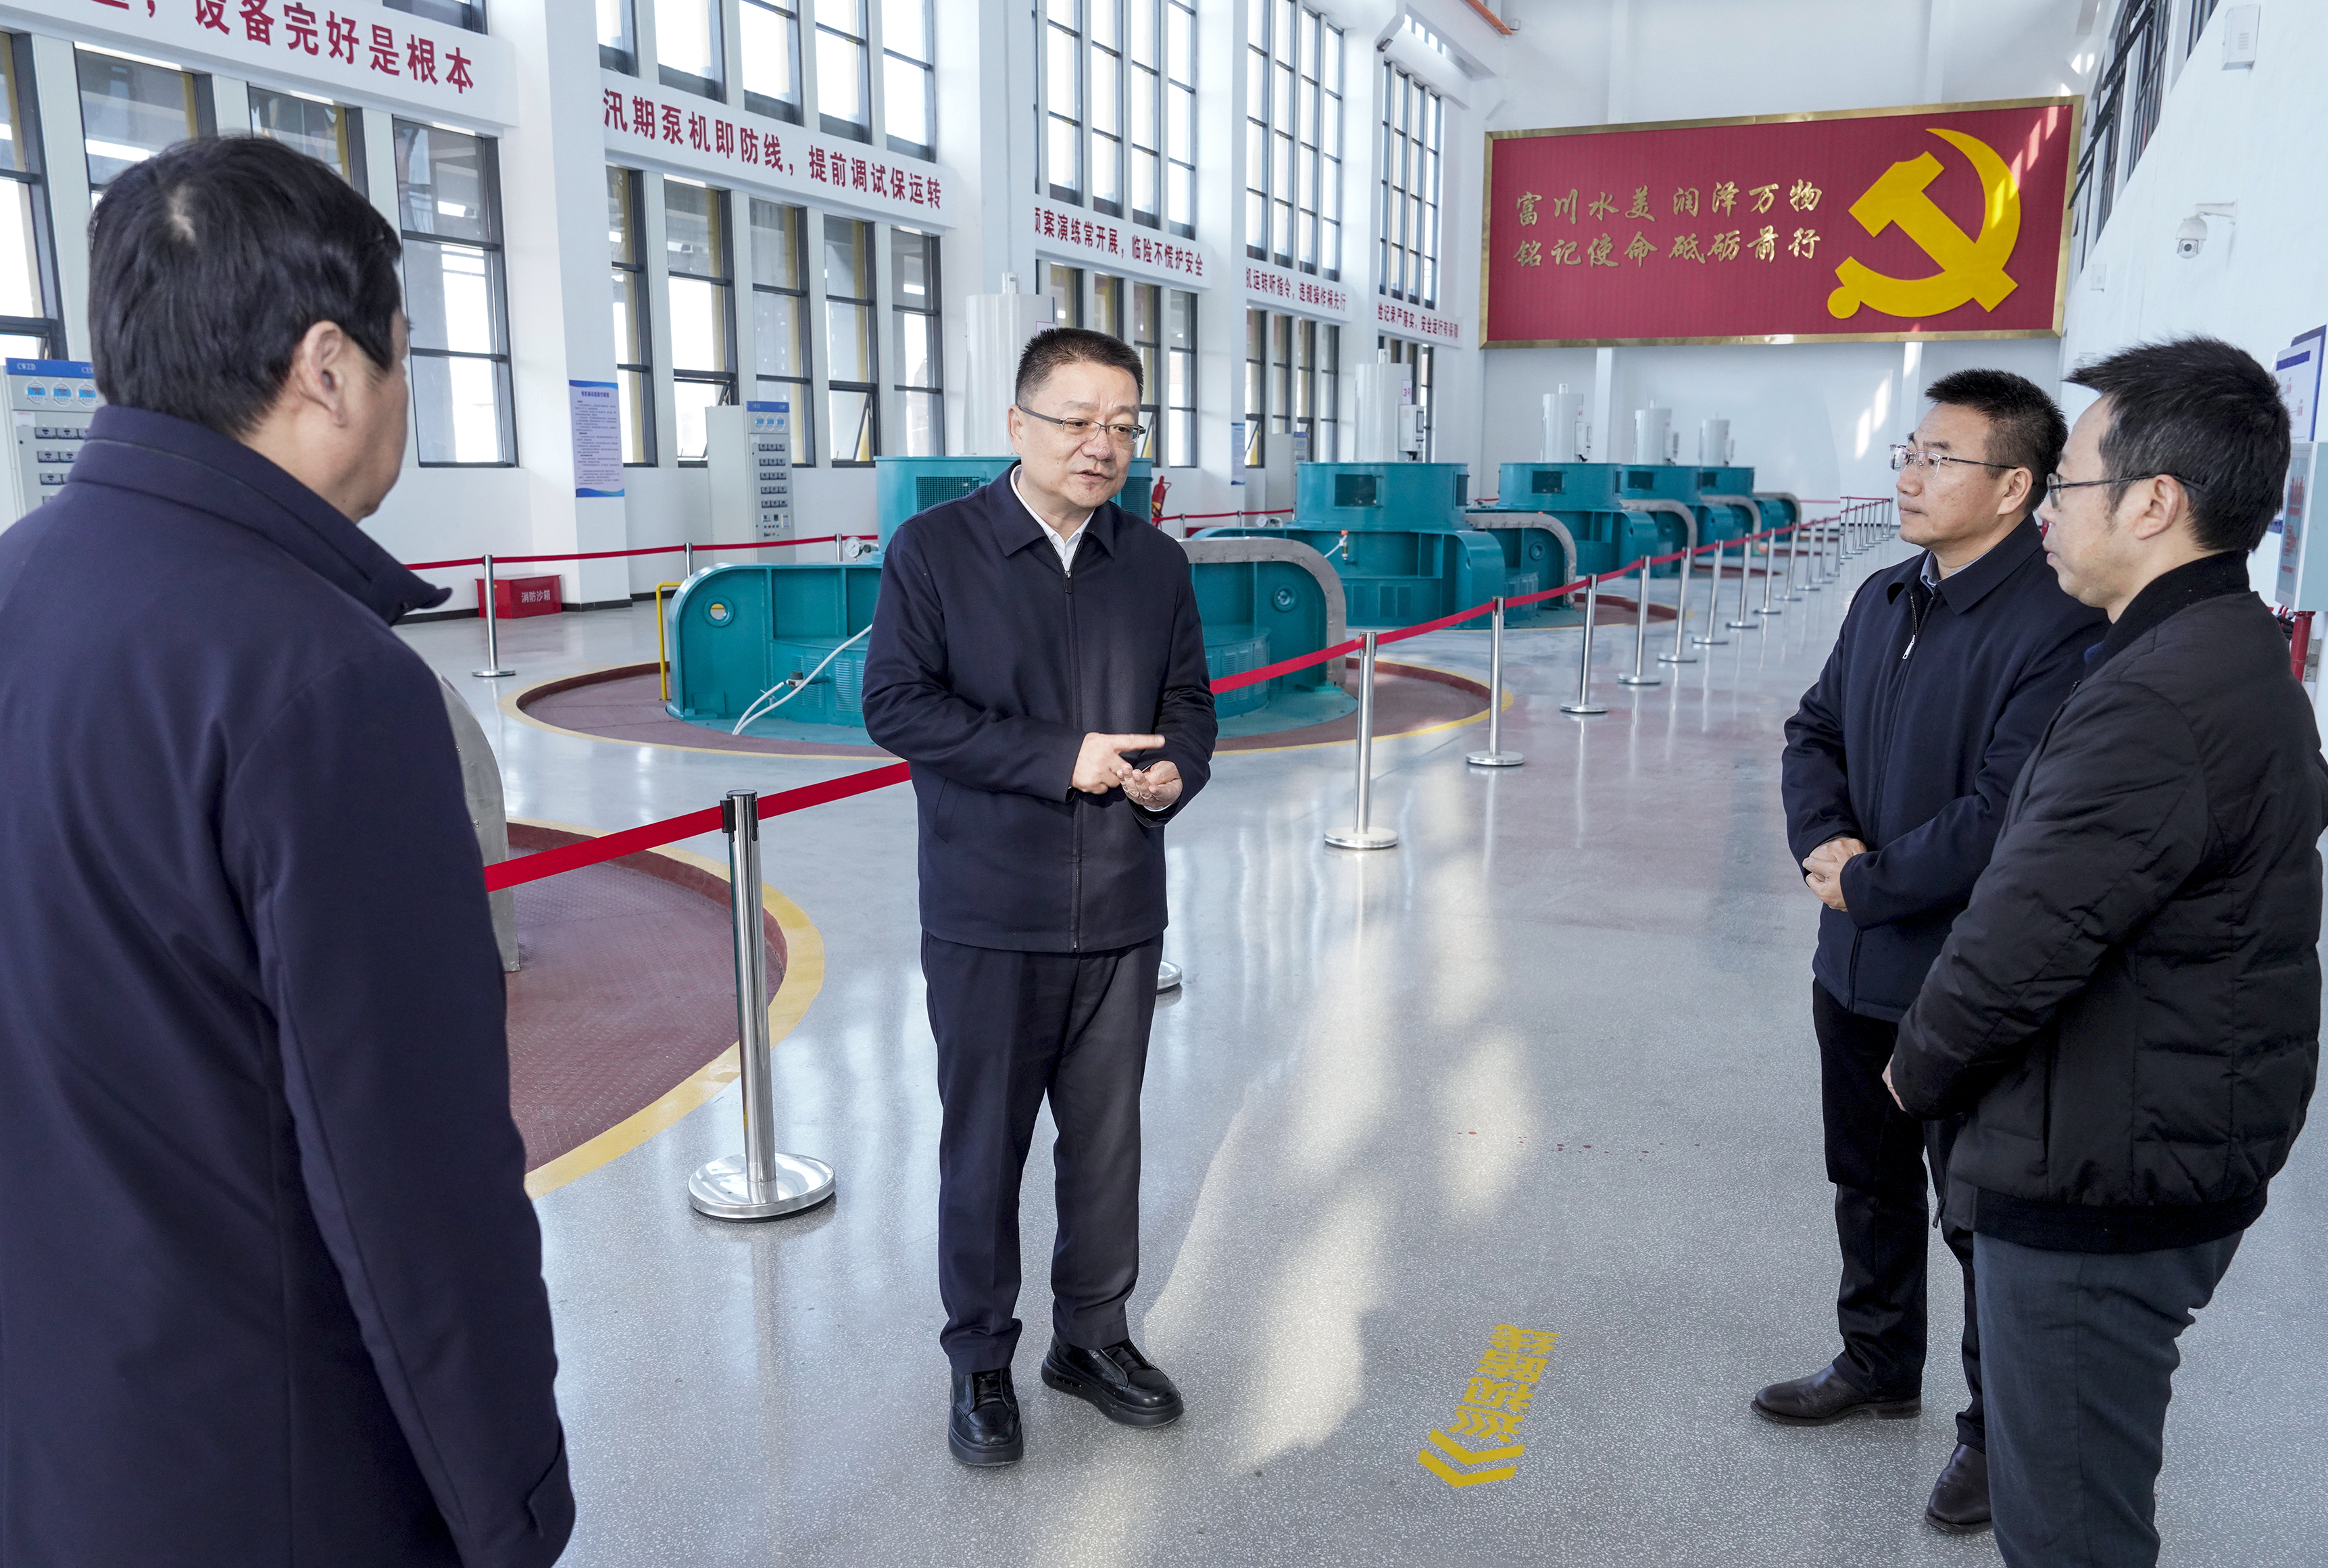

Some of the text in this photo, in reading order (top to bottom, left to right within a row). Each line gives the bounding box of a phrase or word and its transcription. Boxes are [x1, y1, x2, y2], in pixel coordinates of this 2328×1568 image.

[603, 88, 941, 209] 汛期泵机即防线，提前调试保运转
[521, 590, 551, 603] 消防沙箱
[1447, 1324, 1559, 1442] 巡视路线
